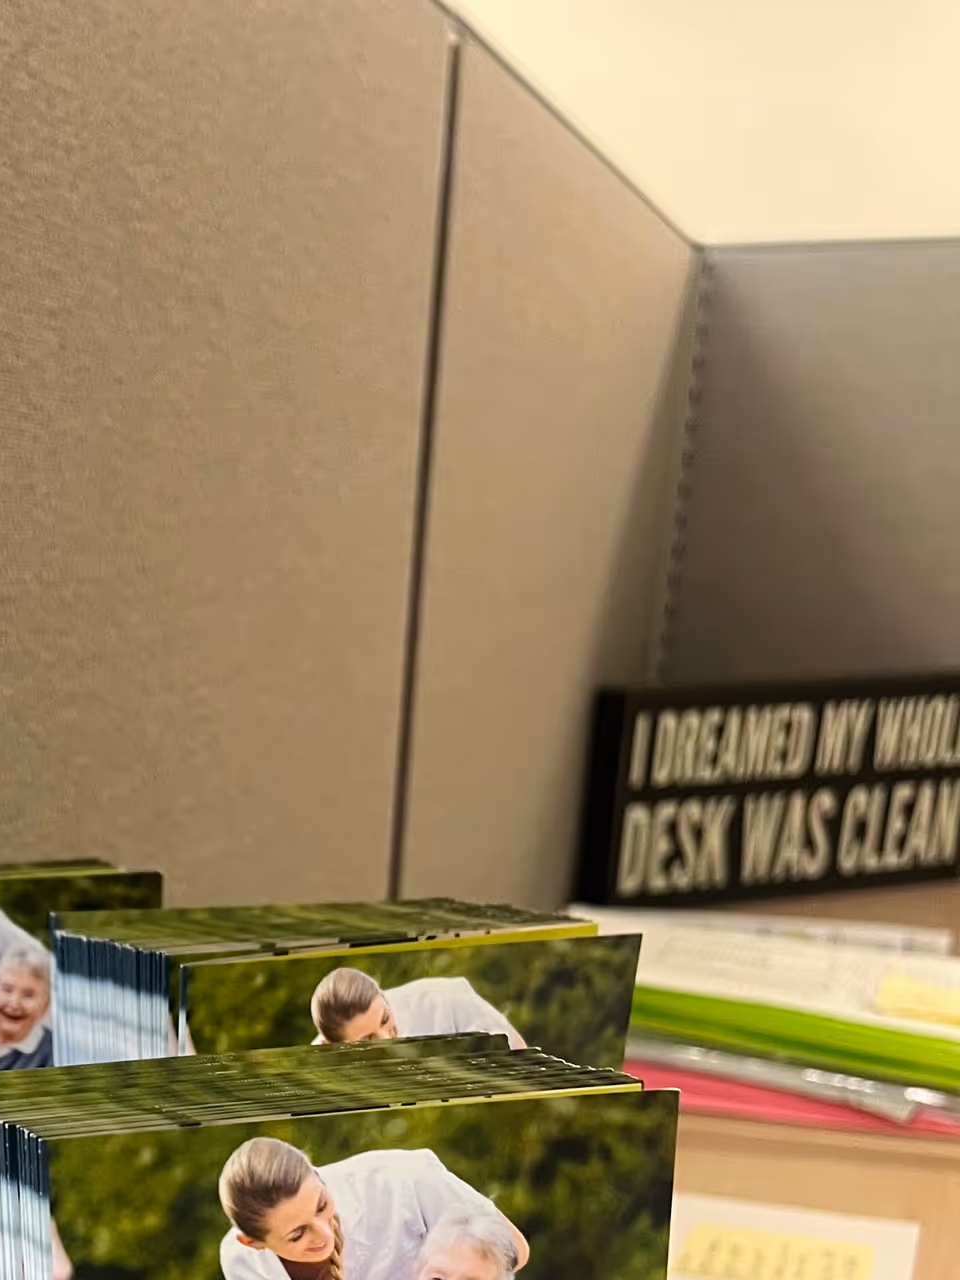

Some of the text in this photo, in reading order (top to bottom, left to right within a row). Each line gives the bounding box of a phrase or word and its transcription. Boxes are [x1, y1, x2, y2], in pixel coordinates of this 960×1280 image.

[629, 693, 960, 789] I DREAMED MY WHOL
[616, 777, 960, 895] DESK WAS CLEAN
